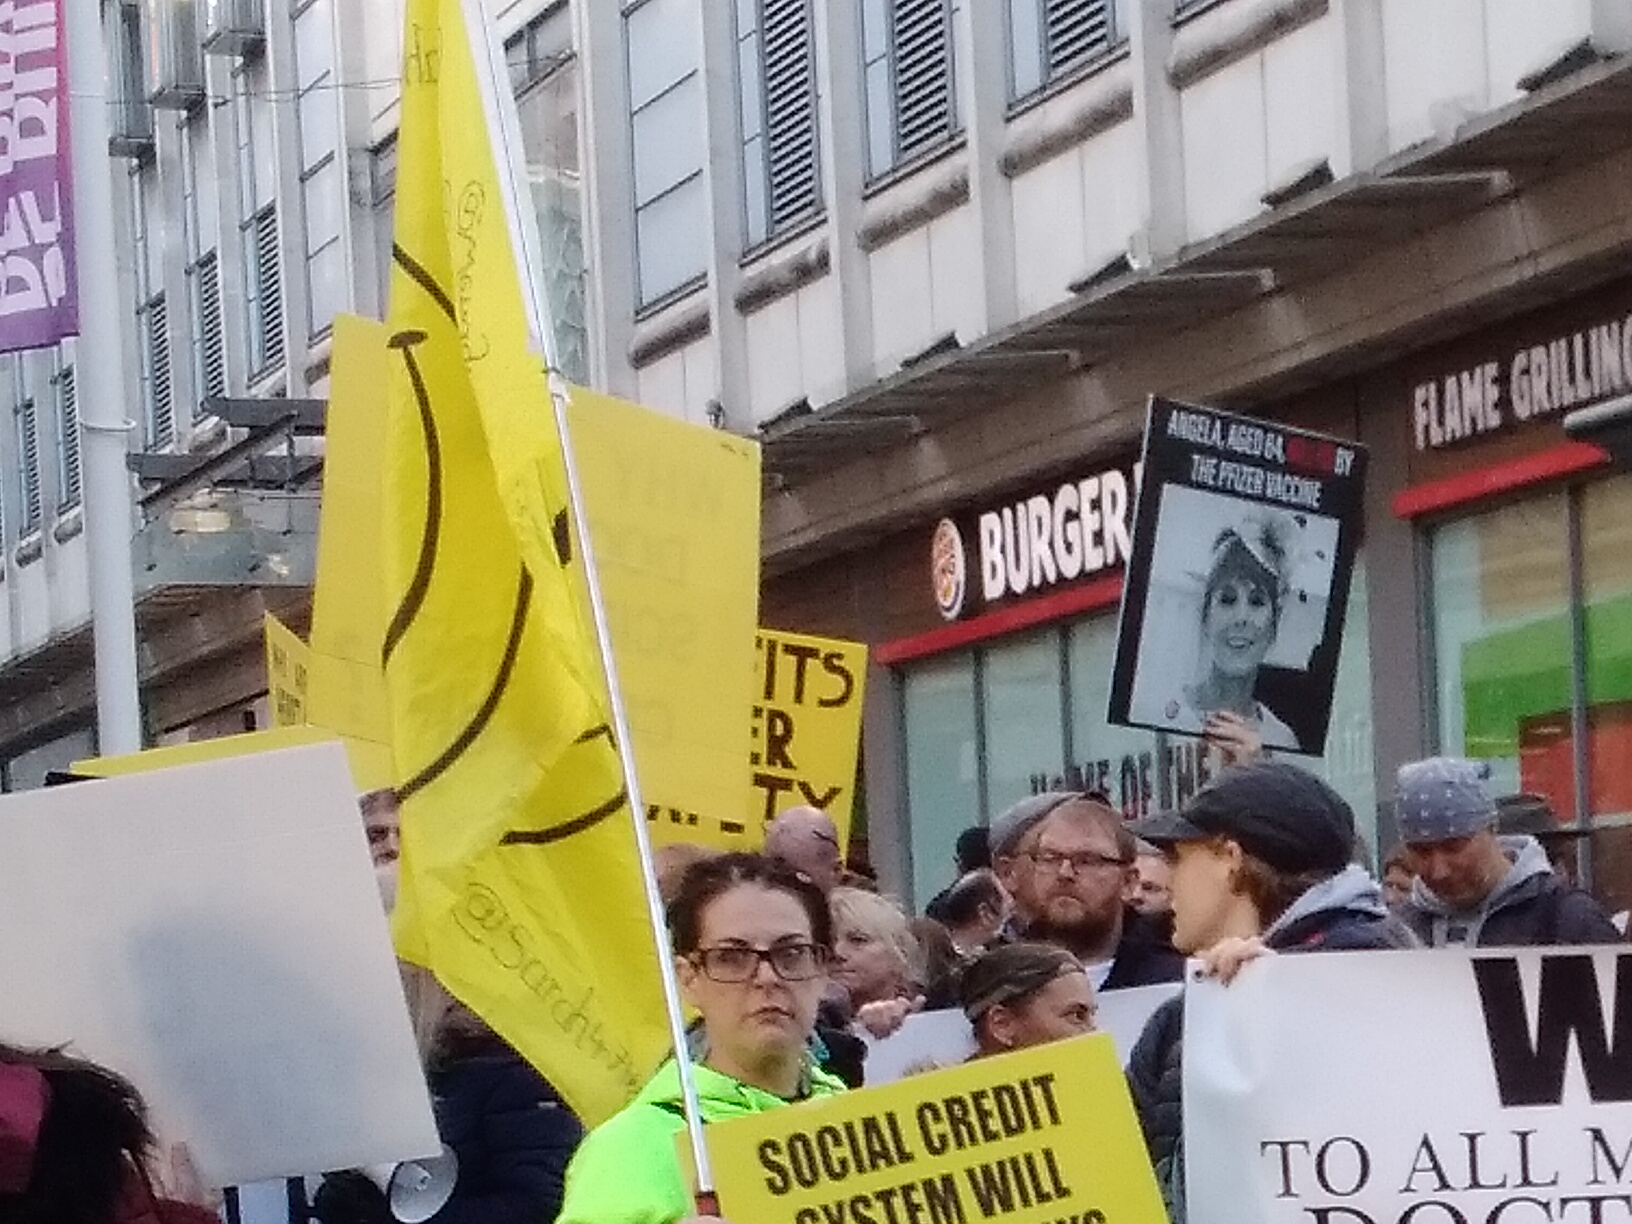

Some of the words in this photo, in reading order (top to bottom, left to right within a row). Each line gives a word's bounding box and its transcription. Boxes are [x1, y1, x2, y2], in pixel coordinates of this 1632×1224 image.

[1413, 361, 1501, 450] FLAME
[1192, 454, 1217, 485] THE
[1219, 461, 1265, 494] PFIZER
[1267, 473, 1322, 508] VACCINE
[979, 468, 1131, 600] BURGER
[756, 635, 855, 709] ITS
[758, 1111, 916, 1197] SOCIAL
[916, 1073, 1063, 1158] CREDIT
[1261, 1136, 1371, 1198] TO
[1401, 1129, 1559, 1192] ALL
[965, 1148, 1072, 1219] WILL
